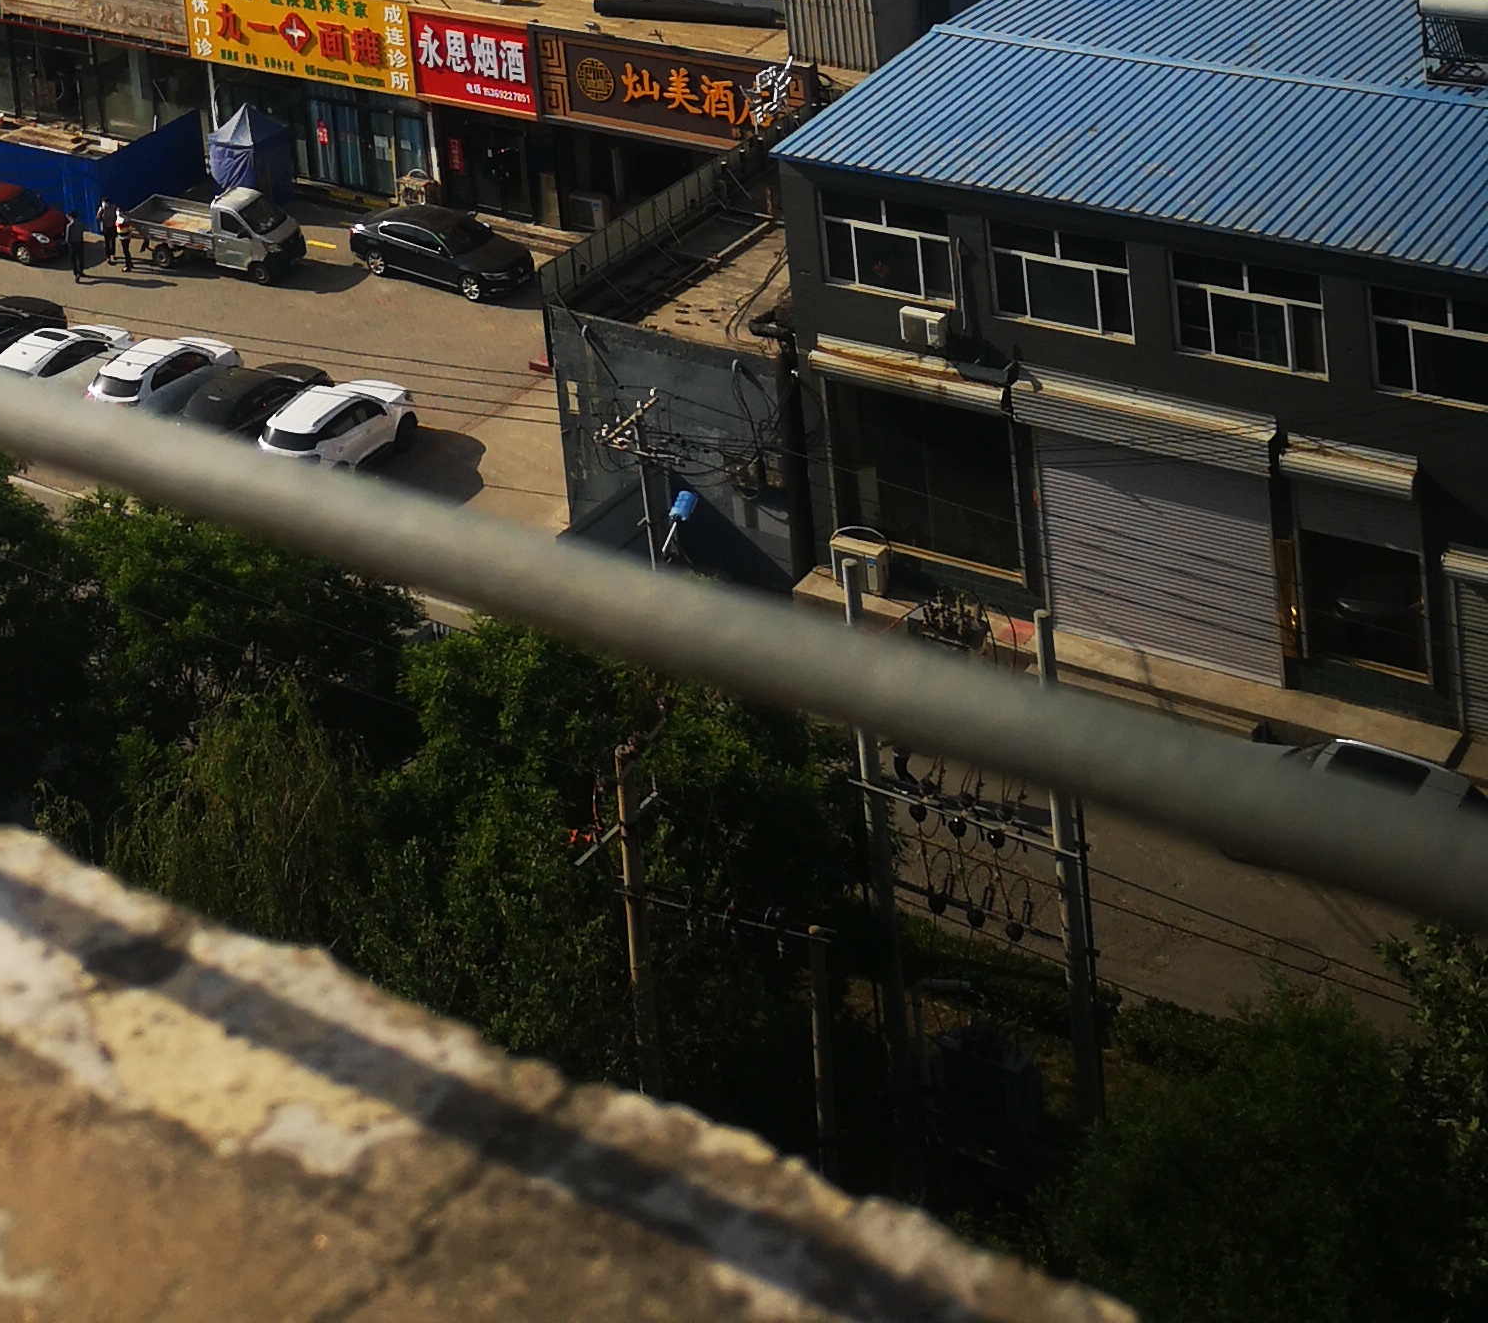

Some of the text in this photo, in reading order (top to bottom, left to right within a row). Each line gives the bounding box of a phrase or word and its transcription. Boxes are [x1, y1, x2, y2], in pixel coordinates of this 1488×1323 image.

[215, 2, 383, 67] 九一 面瘫
[384, 4, 411, 93] 成连诊所
[418, 24, 526, 84] 永恩烟酒
